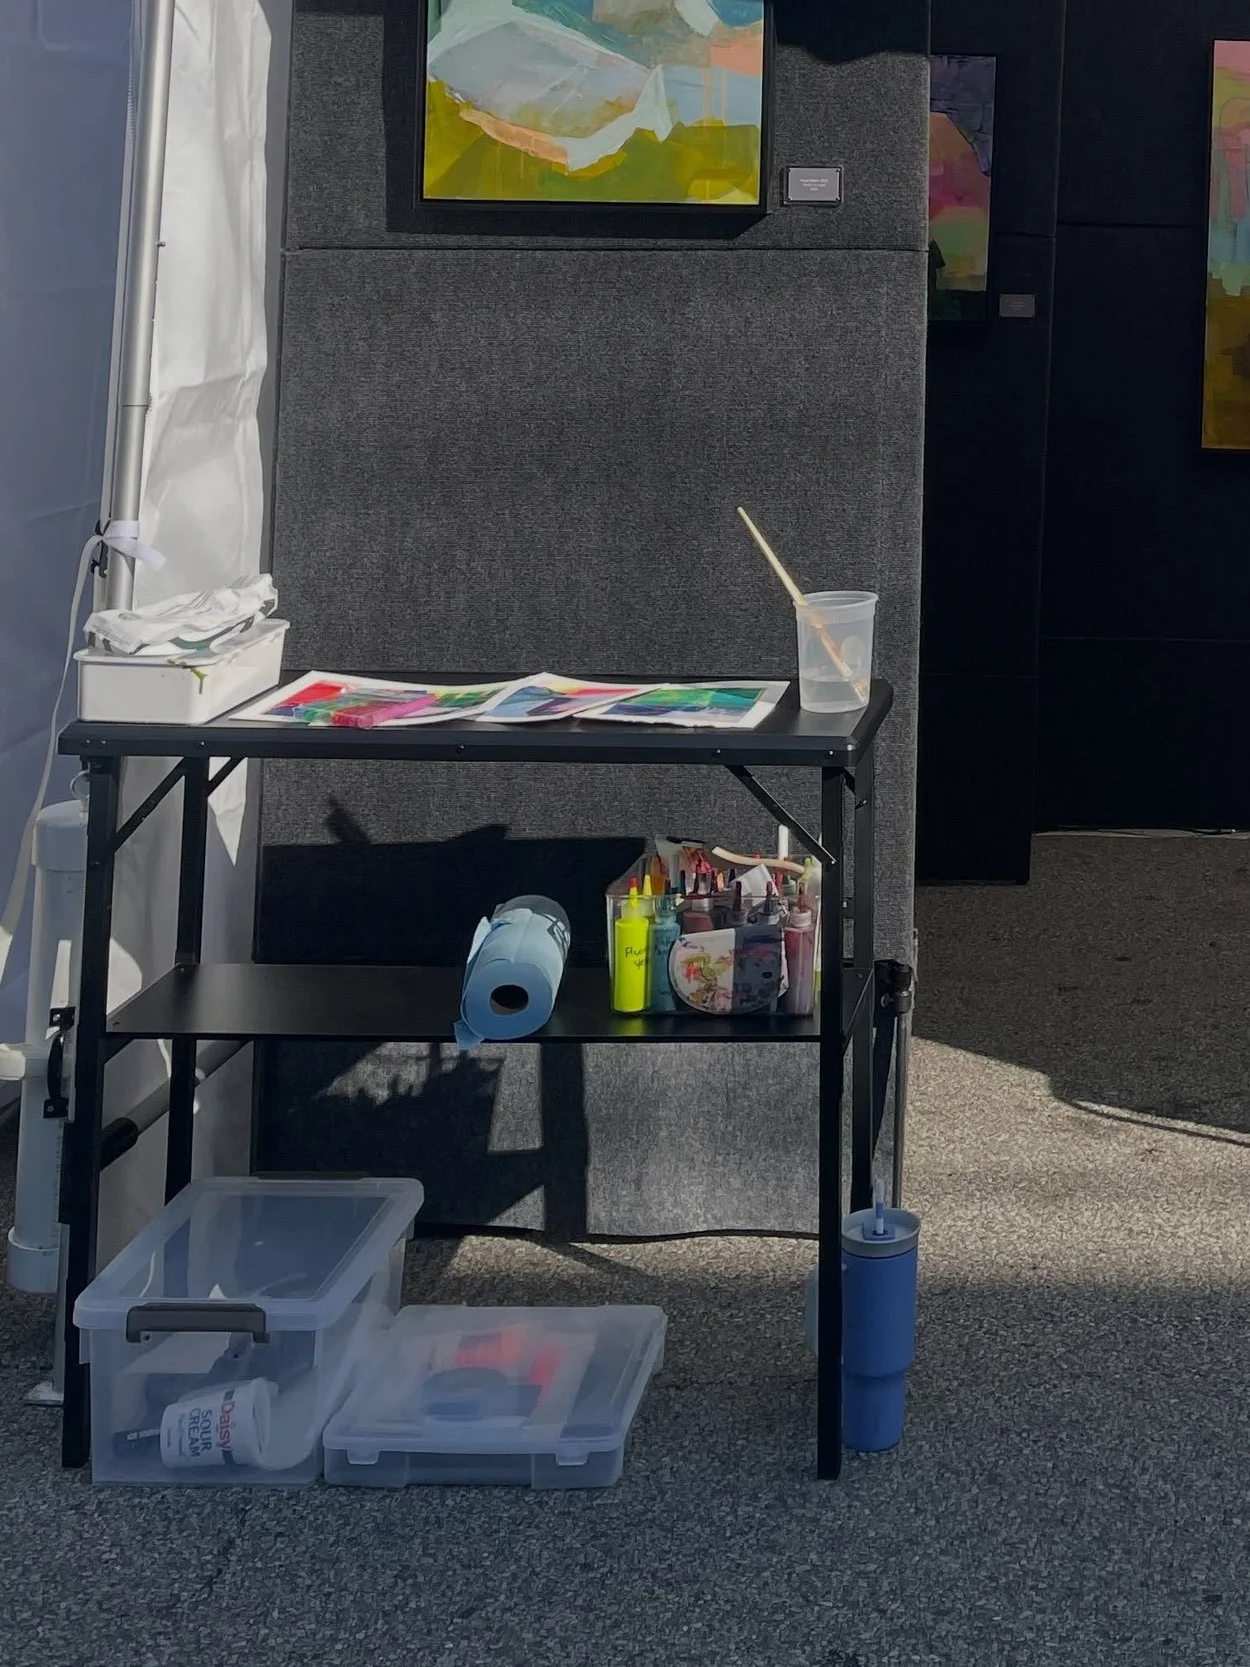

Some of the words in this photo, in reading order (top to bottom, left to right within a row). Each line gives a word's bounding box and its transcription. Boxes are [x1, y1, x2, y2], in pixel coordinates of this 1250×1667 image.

[188, 1408, 201, 1458] CREAM
[200, 1409, 213, 1452] SOUR
[217, 1401, 236, 1452] Daisy
